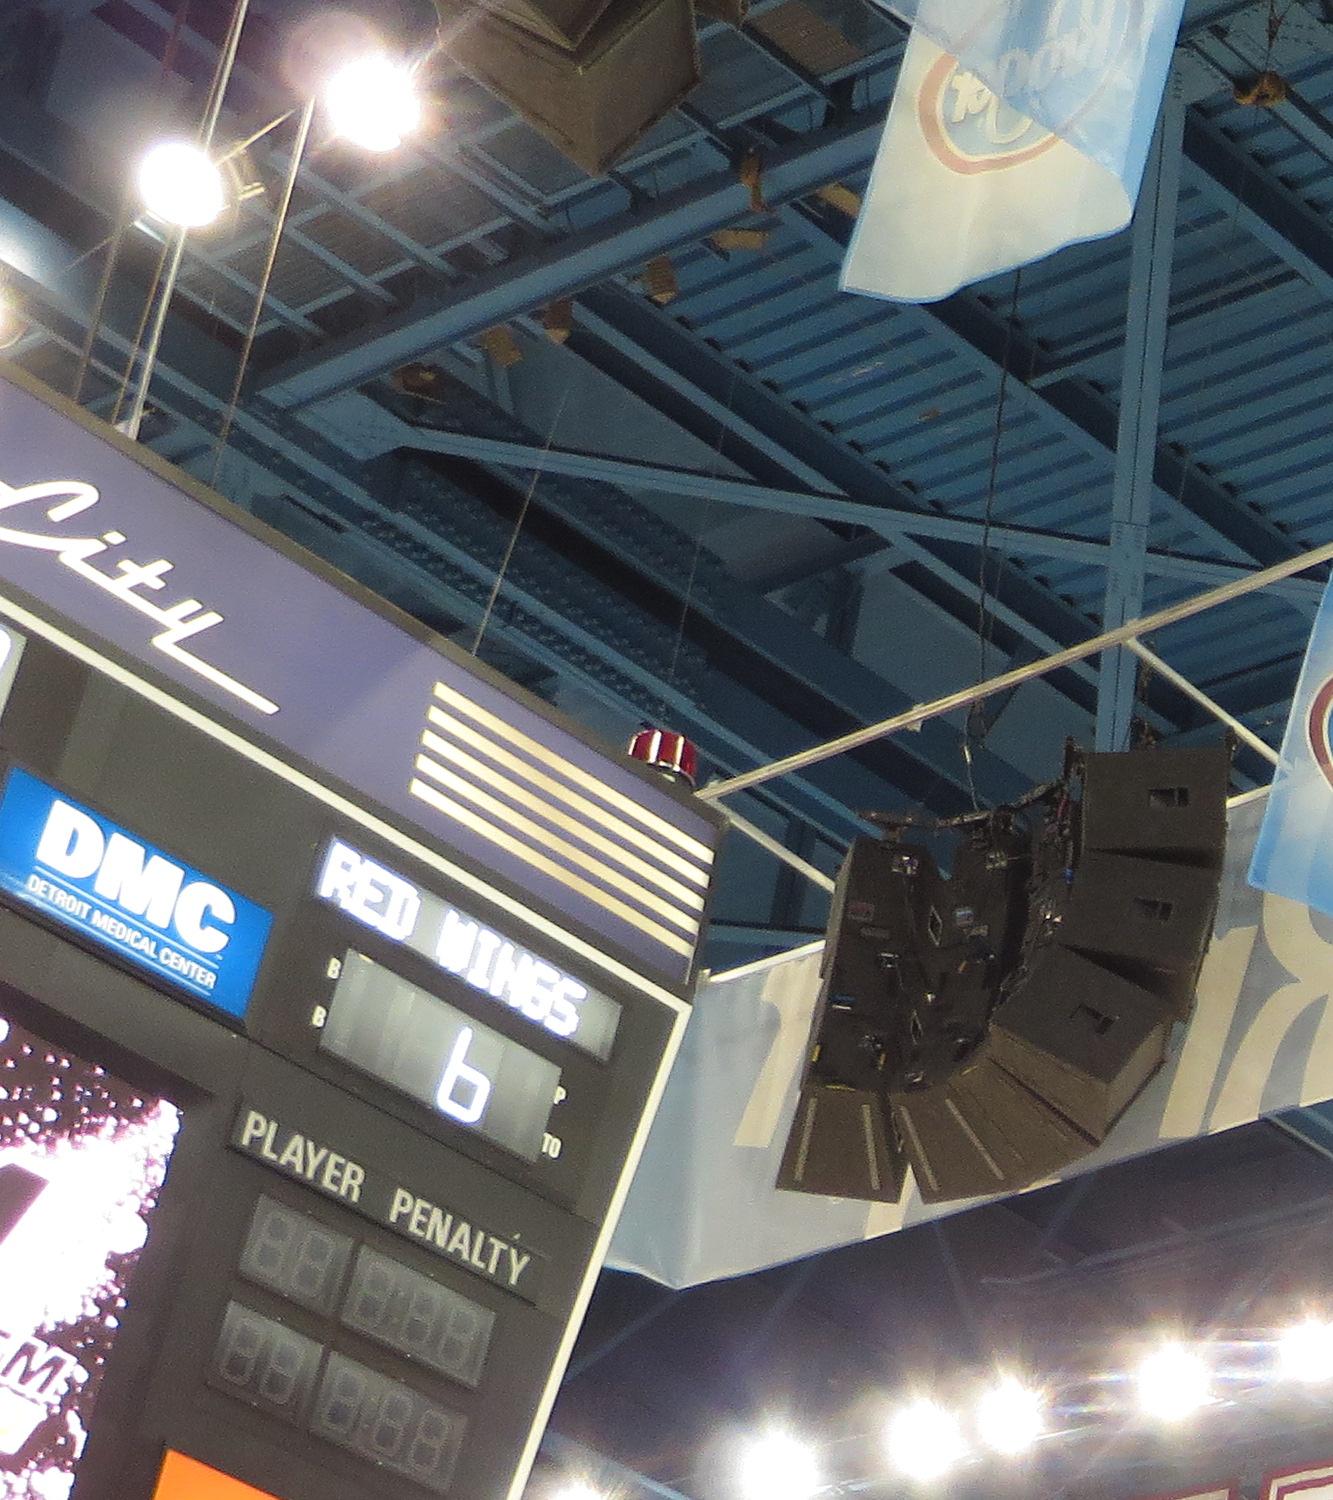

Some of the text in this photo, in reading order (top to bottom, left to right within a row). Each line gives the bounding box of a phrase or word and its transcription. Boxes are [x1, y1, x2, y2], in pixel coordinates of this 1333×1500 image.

[27, 874, 216, 989] DETROIT MEDICAL CENTER
[36, 799, 236, 953] DMC
[318, 840, 588, 1038] RED WINGS
[435, 1024, 491, 1124] 6
[241, 1110, 531, 1287] PLAYER PENALTY
